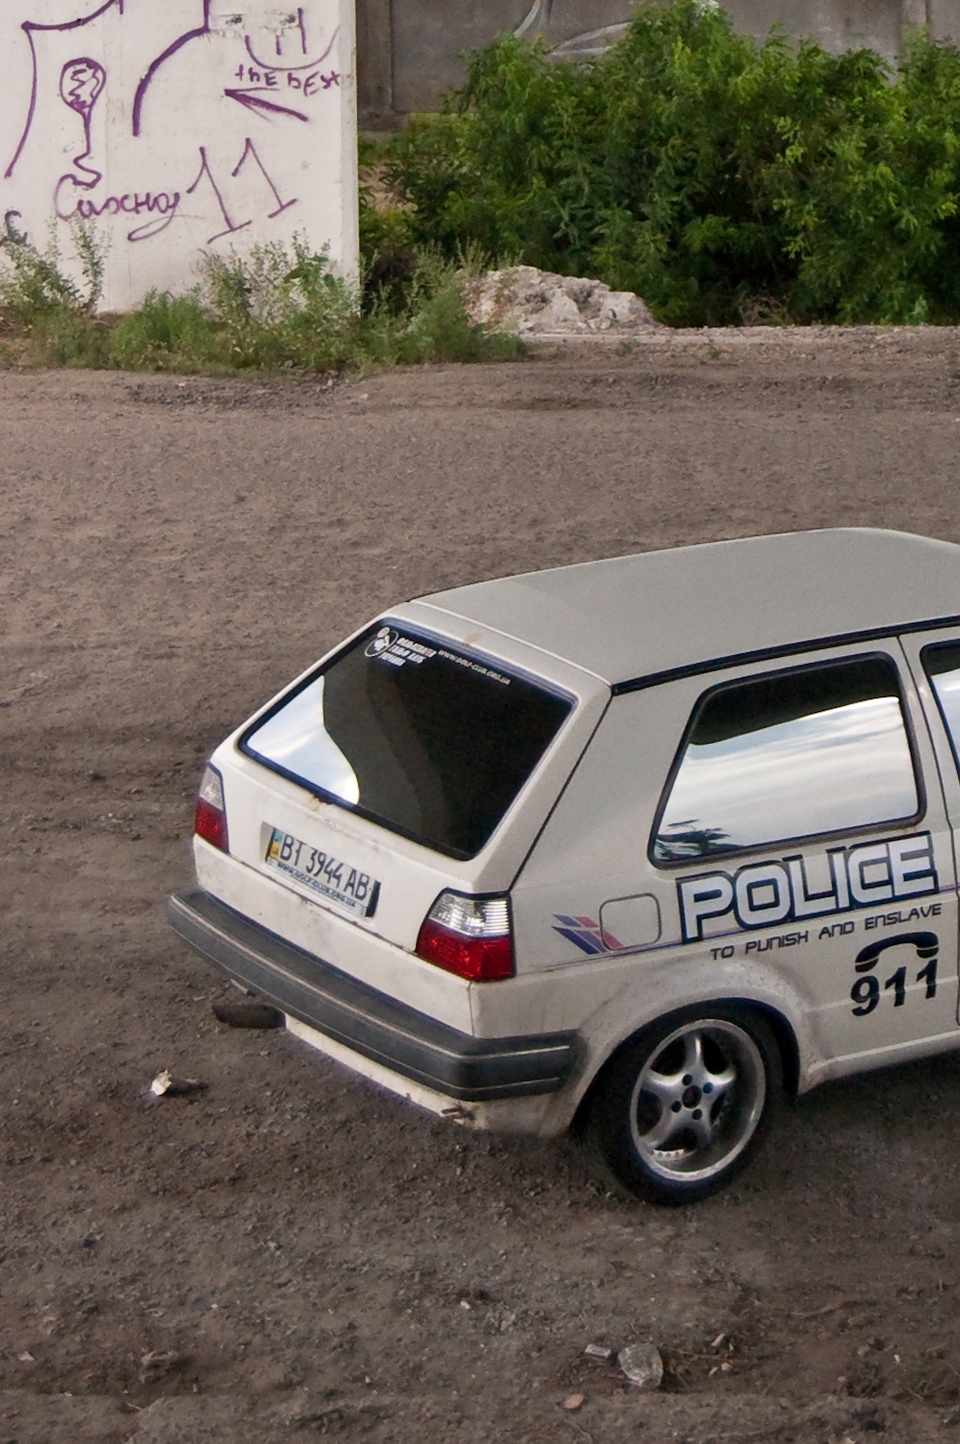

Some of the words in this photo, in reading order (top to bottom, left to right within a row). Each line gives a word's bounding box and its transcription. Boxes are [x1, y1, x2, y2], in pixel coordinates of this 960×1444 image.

[280, 833, 307, 867] BT
[305, 846, 344, 888] 3944
[343, 868, 370, 901] AB
[675, 830, 940, 944] POLICE
[710, 945, 736, 961] TO
[744, 930, 809, 955] PUNISH
[818, 920, 855, 941] AND
[864, 902, 943, 931] ENSLAVE
[850, 958, 939, 1017] 911
